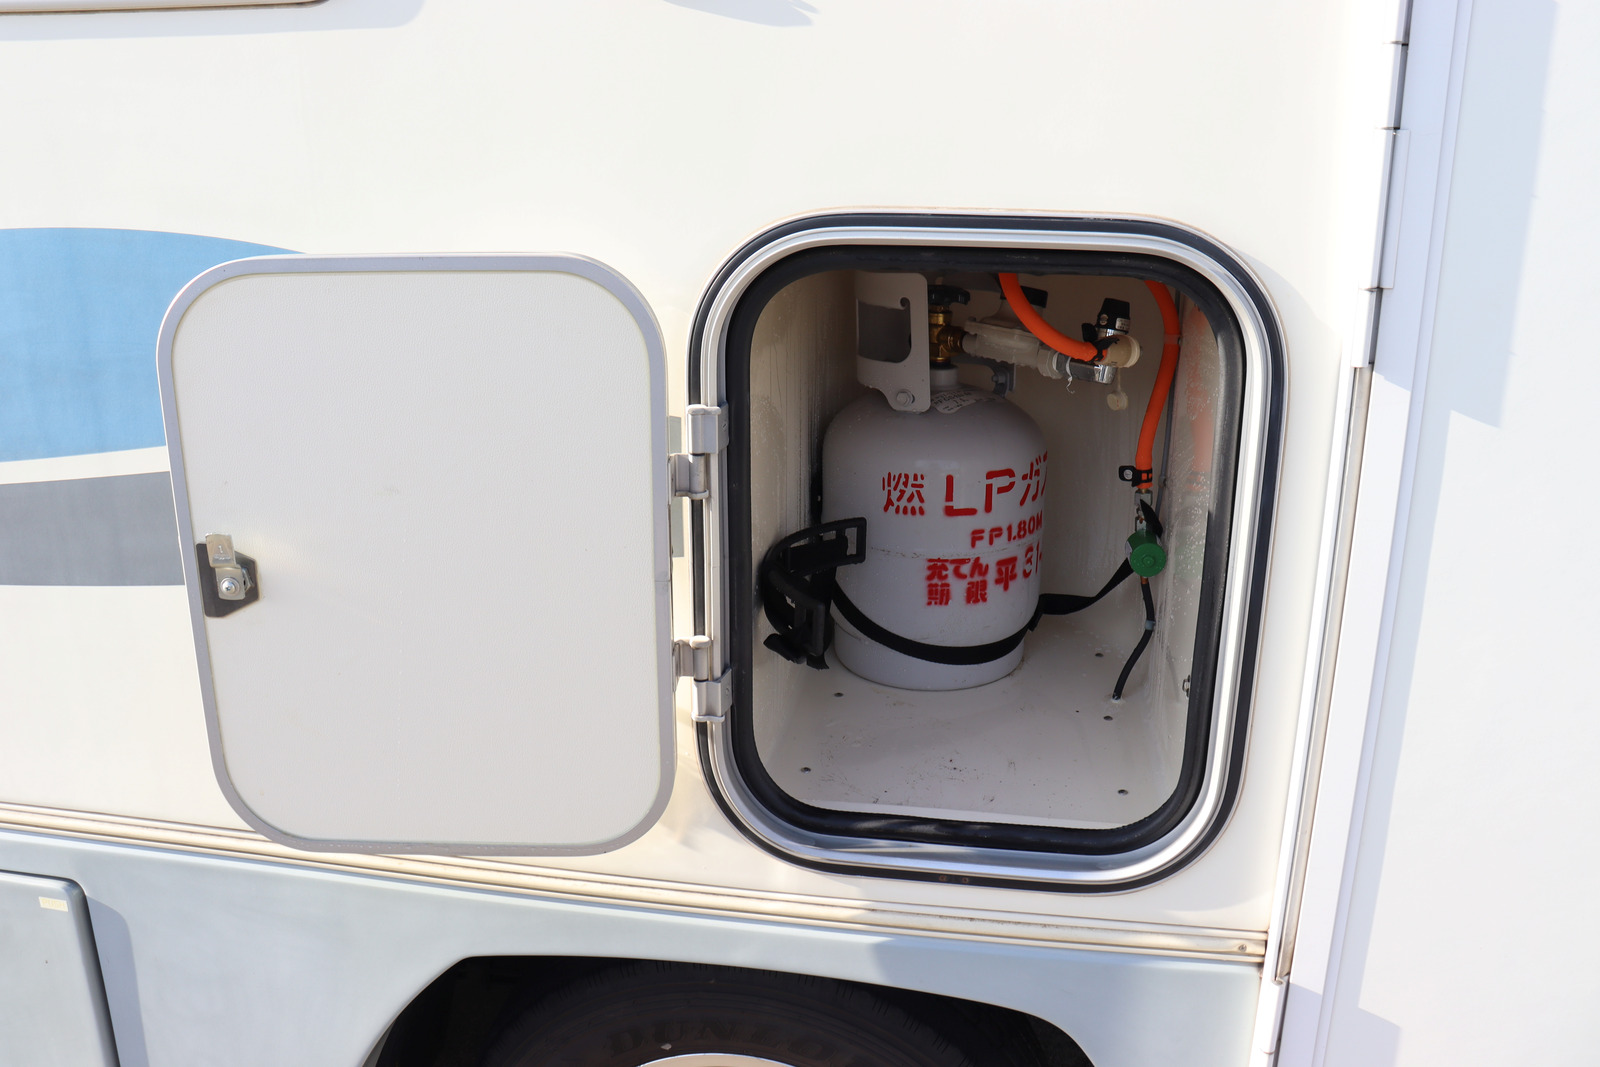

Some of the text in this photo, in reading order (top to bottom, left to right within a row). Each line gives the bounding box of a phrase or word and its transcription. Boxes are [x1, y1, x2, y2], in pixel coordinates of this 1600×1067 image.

[882, 471, 926, 516] 燃
[926, 556, 989, 581] 充てん
[994, 541, 1043, 592] 平31
[41, 898, 65, 909] PUSH
